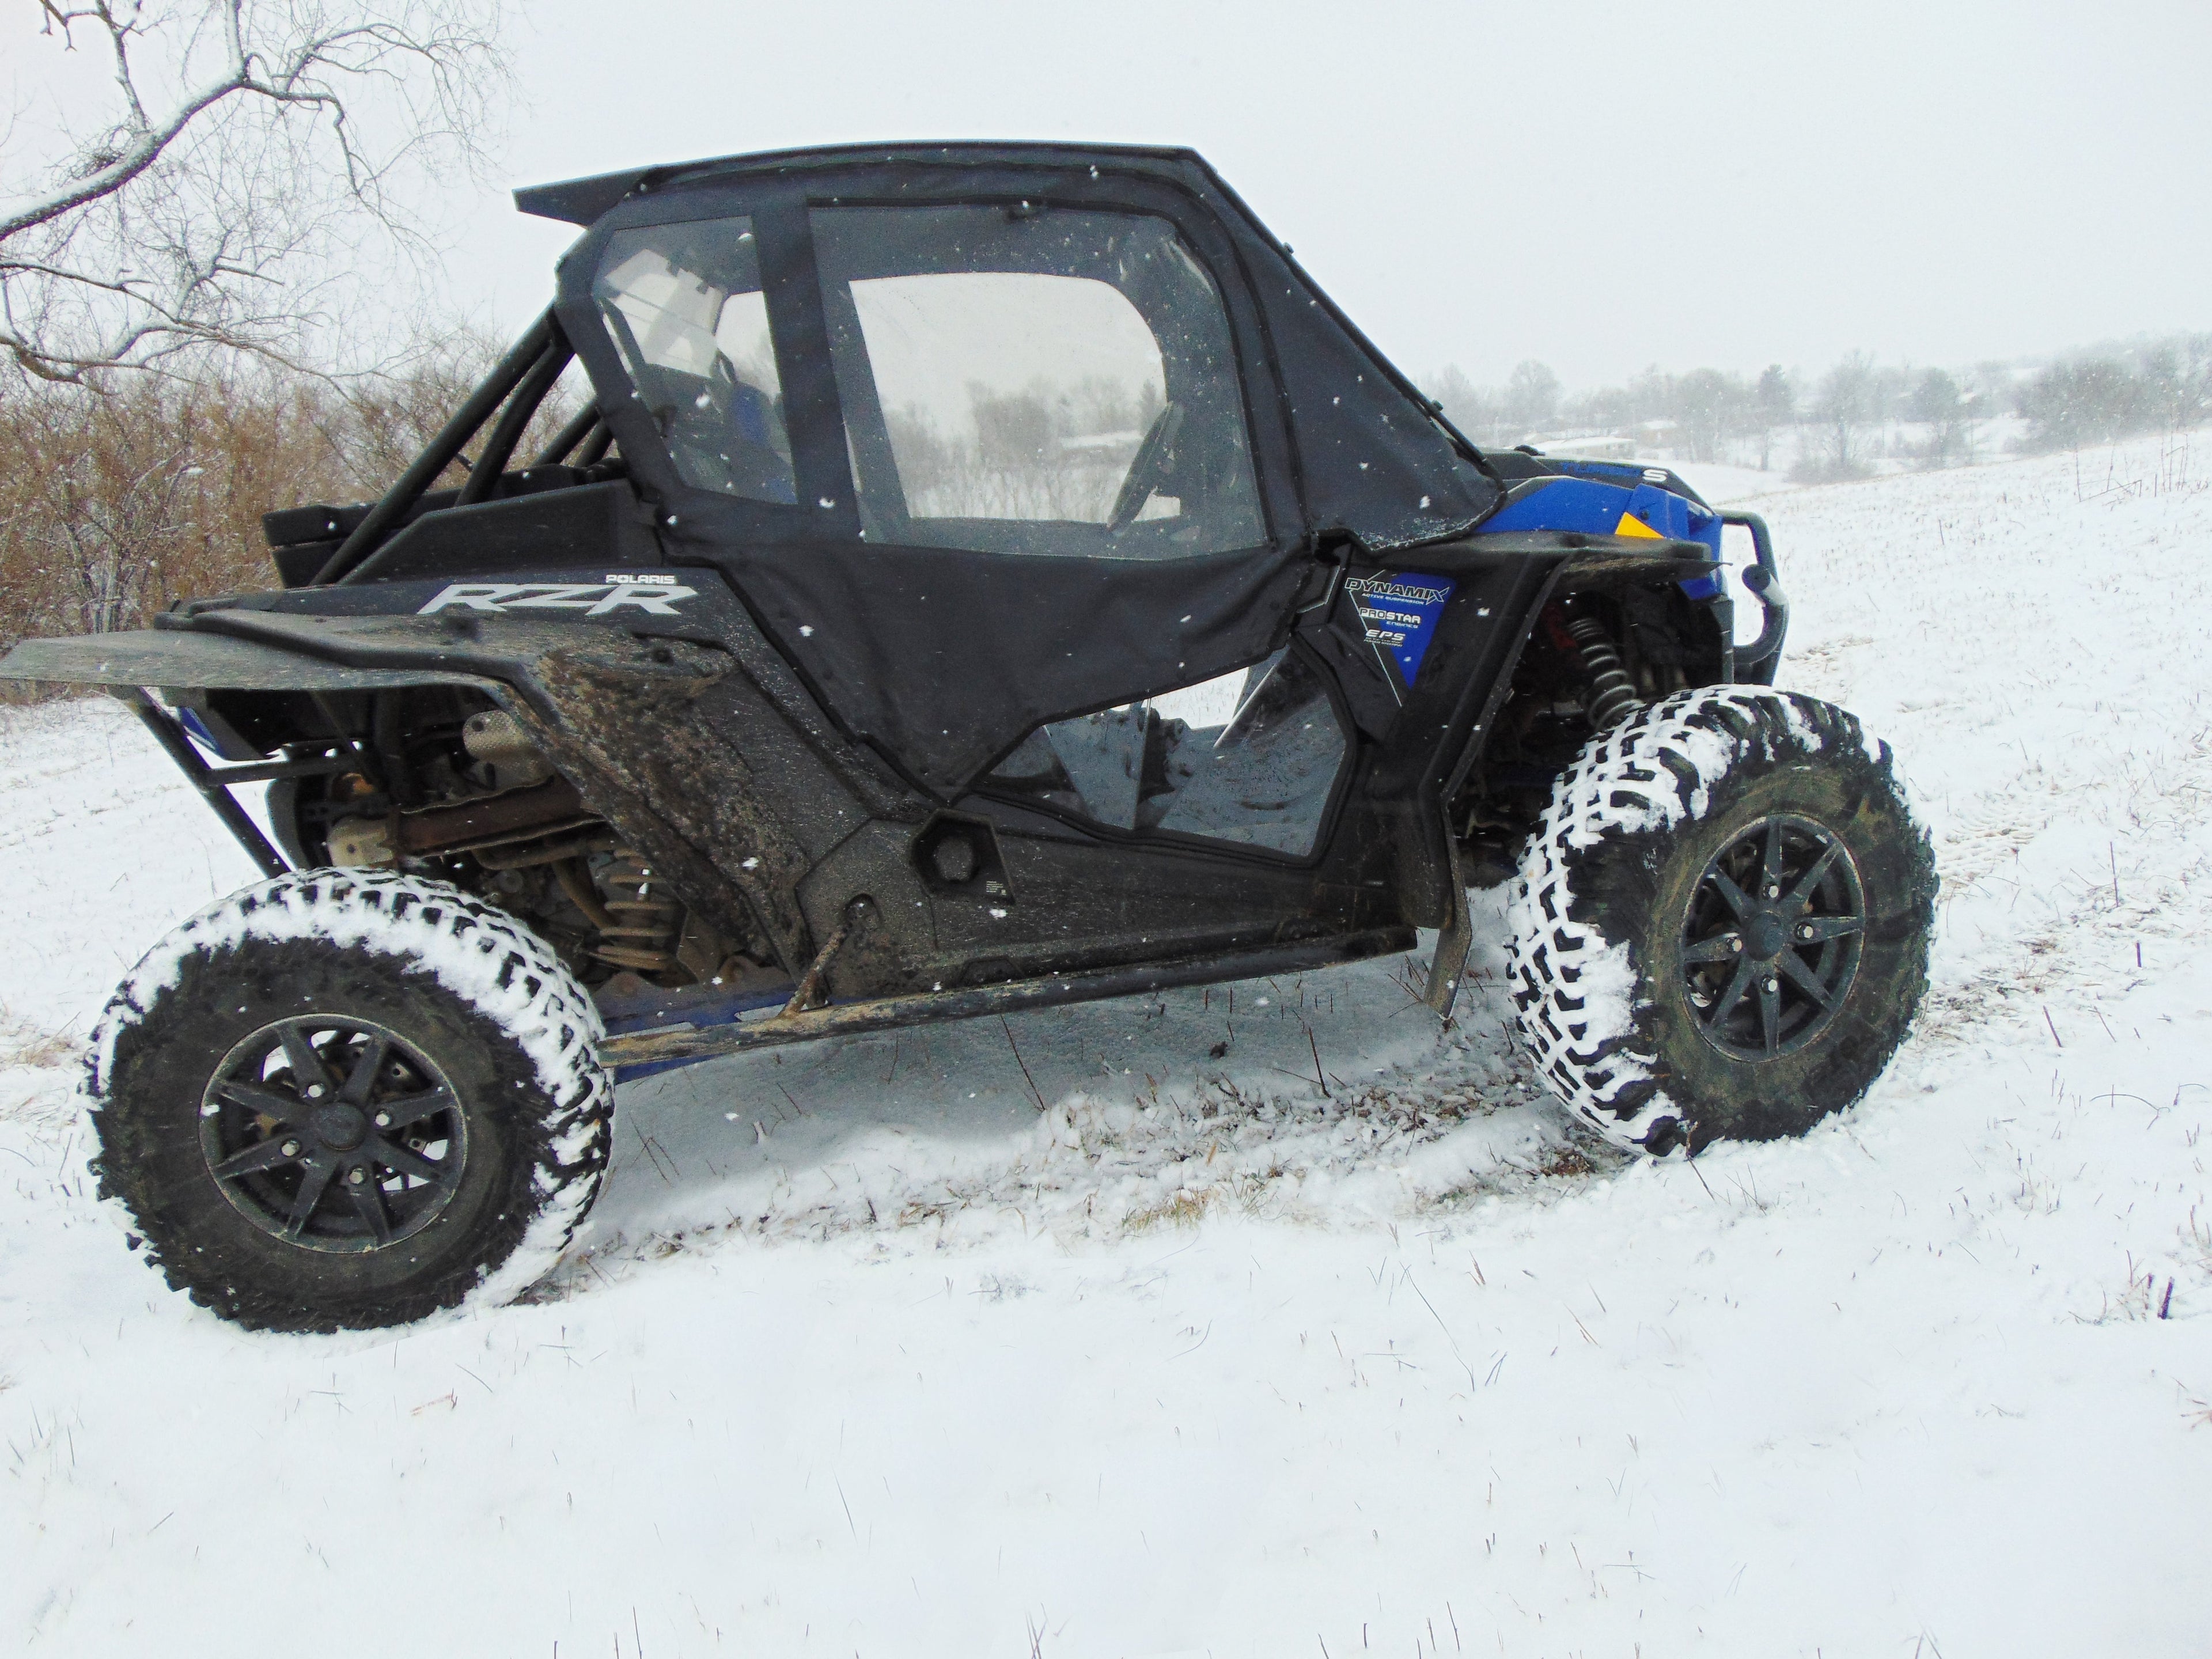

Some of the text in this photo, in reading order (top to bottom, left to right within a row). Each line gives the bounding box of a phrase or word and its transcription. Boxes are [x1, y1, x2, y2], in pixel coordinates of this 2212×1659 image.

[606, 574, 675, 584] POLARIS
[1344, 578, 1450, 605] DYNAMIX
[416, 584, 698, 615] RZR
[1385, 596, 1424, 605] SUSPENSION
[1359, 607, 1421, 624] PROSTAR
[1365, 629, 1406, 641] EPS
